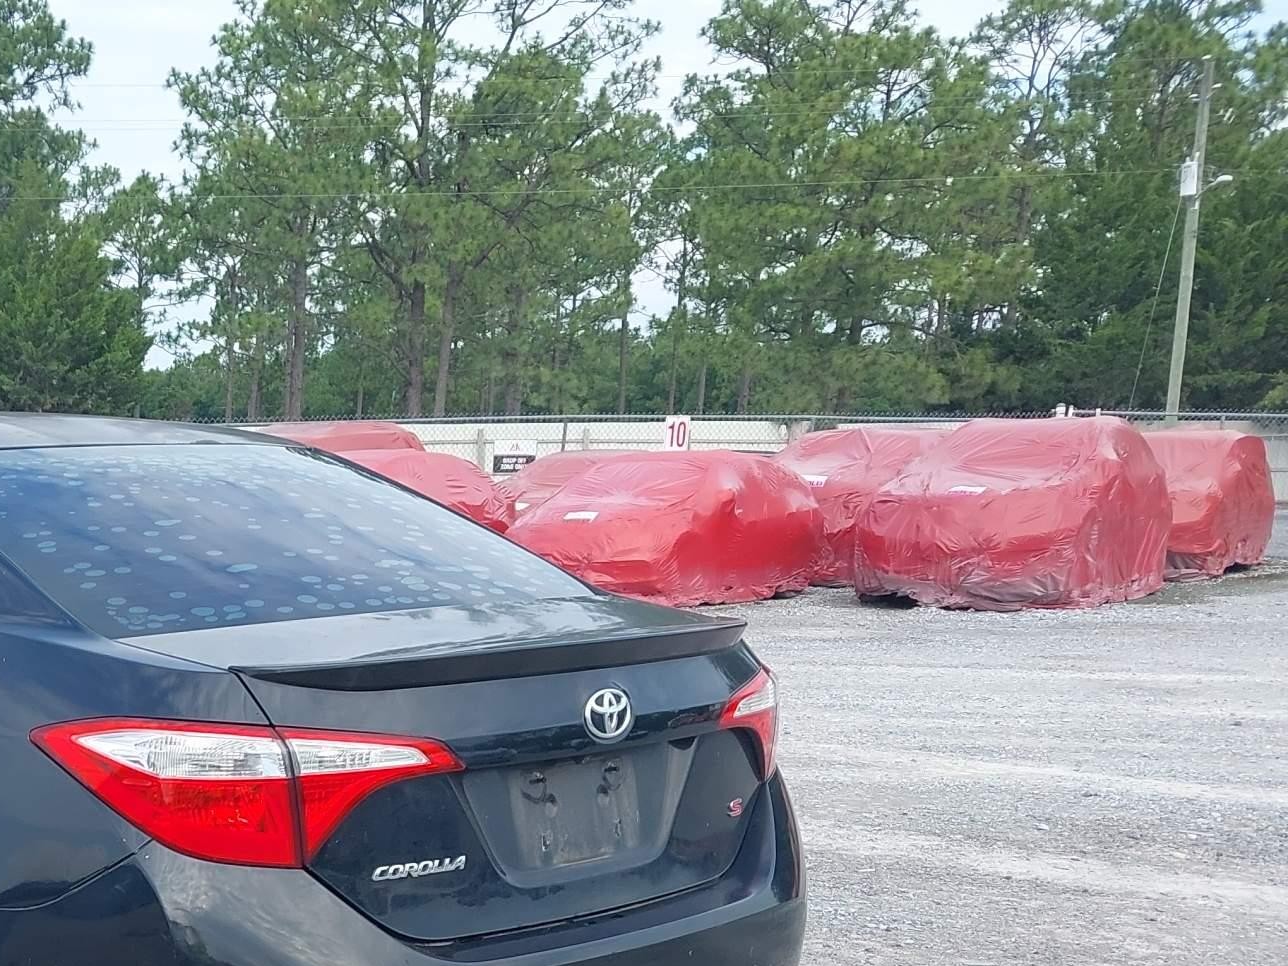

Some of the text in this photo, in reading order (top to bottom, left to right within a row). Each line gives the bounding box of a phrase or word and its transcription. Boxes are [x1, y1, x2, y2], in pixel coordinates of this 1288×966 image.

[668, 421, 687, 447] 10
[728, 798, 743, 816] S
[372, 855, 466, 881] COROLLA
